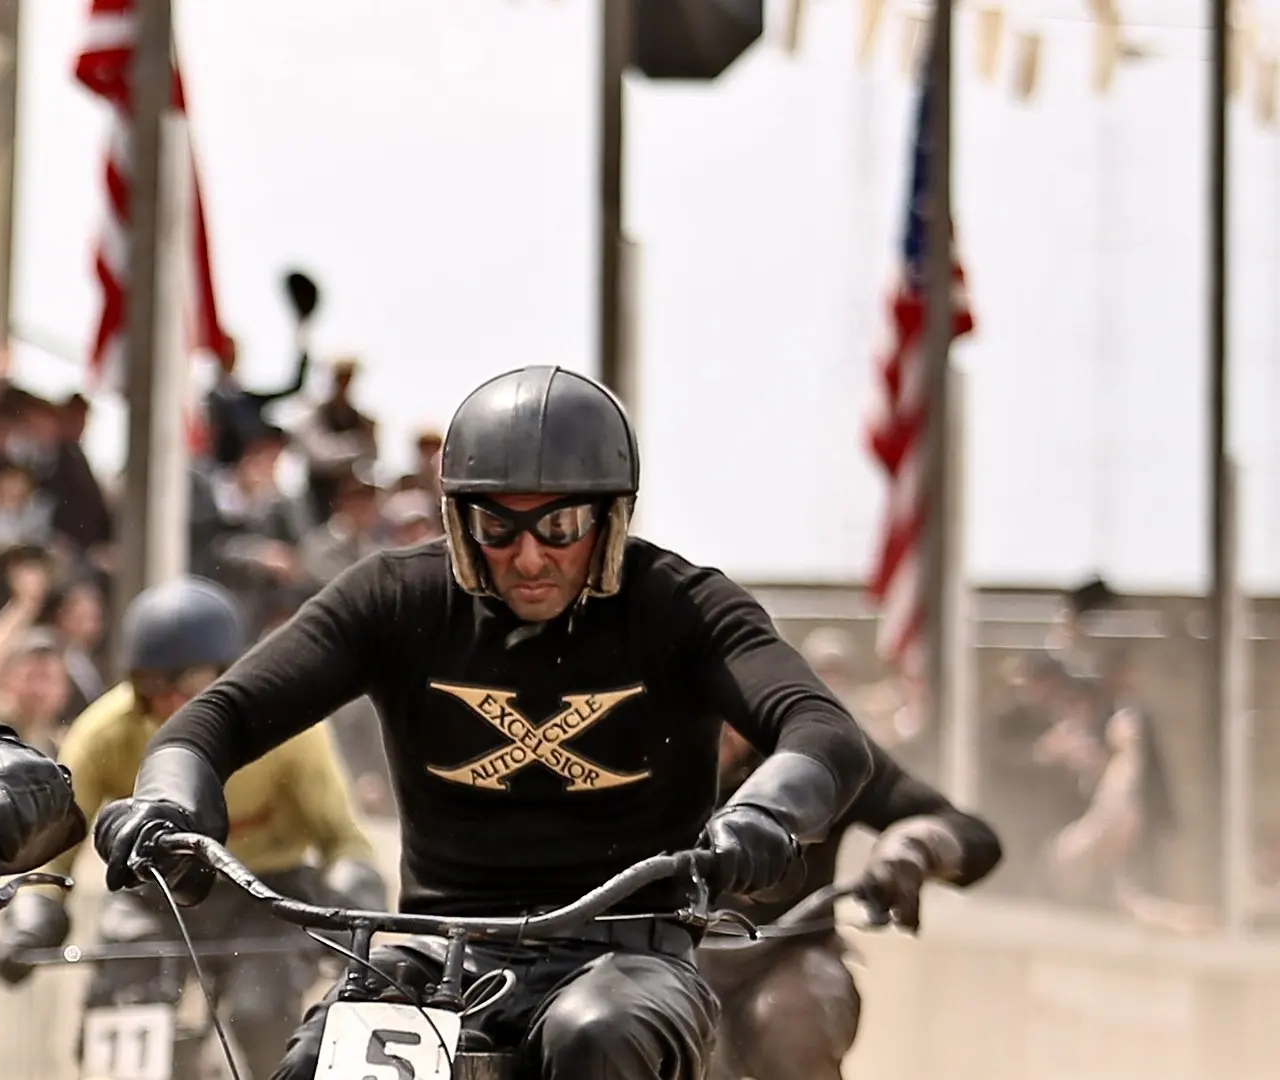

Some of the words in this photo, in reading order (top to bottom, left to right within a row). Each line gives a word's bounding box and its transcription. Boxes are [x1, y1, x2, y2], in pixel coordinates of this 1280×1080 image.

[471, 745, 527, 785] AUTO
[542, 694, 603, 744] CYCLE
[478, 694, 600, 787] EXCELSIOR
[99, 1025, 151, 1075] 11
